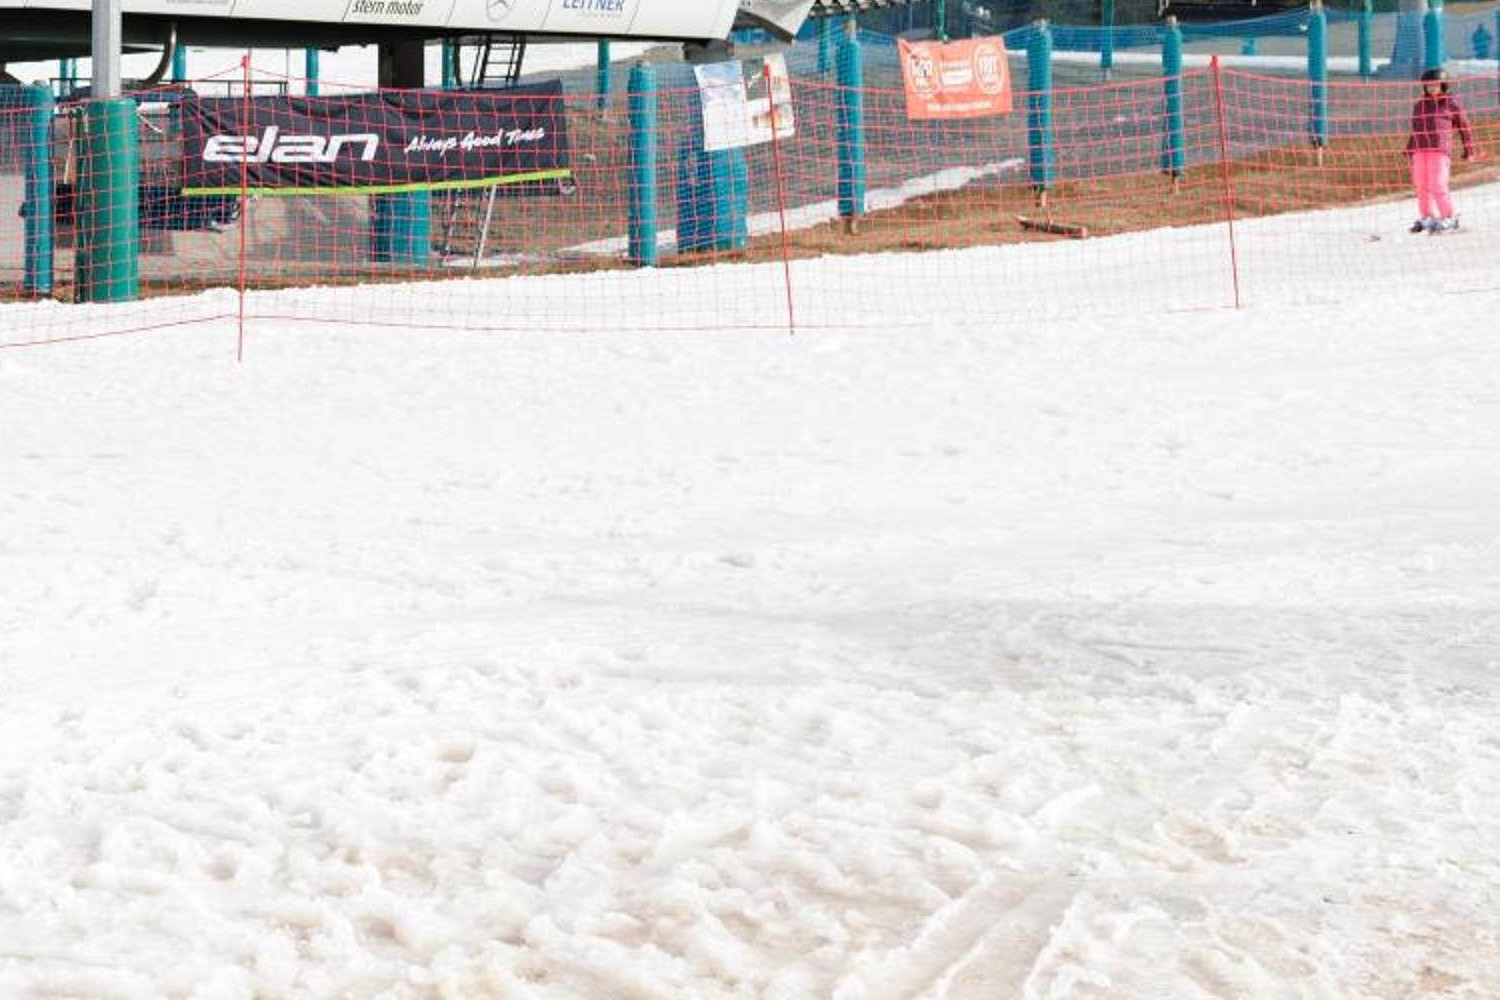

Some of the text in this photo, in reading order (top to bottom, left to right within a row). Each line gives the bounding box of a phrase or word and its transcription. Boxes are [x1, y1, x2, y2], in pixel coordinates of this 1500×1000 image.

[385, 0, 424, 17] motor
[202, 126, 378, 163] elan
[461, 131, 503, 151] Good
